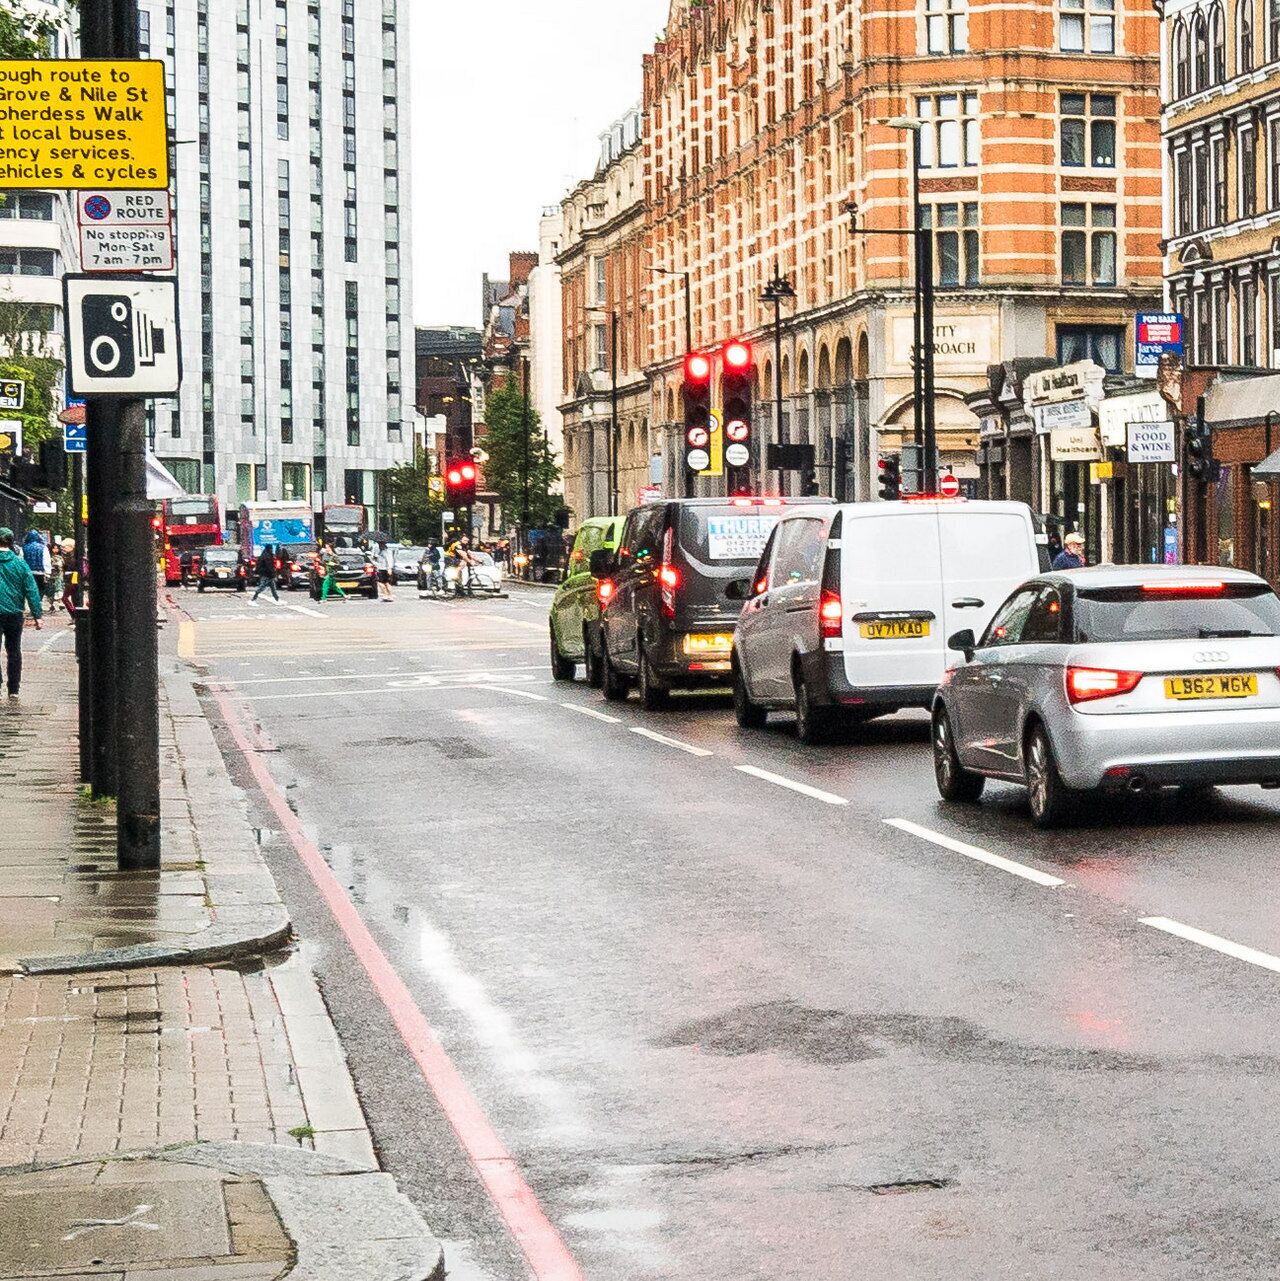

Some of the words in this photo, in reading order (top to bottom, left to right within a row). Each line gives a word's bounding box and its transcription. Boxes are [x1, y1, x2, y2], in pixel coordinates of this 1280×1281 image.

[50, 68, 102, 83] route
[110, 68, 130, 82] to
[59, 87, 72, 102] &
[81, 87, 118, 102] Nile
[126, 87, 149, 102] St
[94, 106, 143, 121] Walk
[13, 125, 62, 140] local
[72, 164, 86, 179] &
[94, 164, 158, 181] cycles
[125, 195, 154, 207] RED
[116, 208, 165, 219] ROUTE
[86, 230, 105, 240] No
[109, 230, 165, 241] stopping
[933, 325, 956, 337] ITY
[1135, 432, 1167, 441] FOOD
[1141, 442, 1172, 451] WINE
[1170, 678, 1215, 695] LB62
[1220, 676, 1252, 693] WGK
